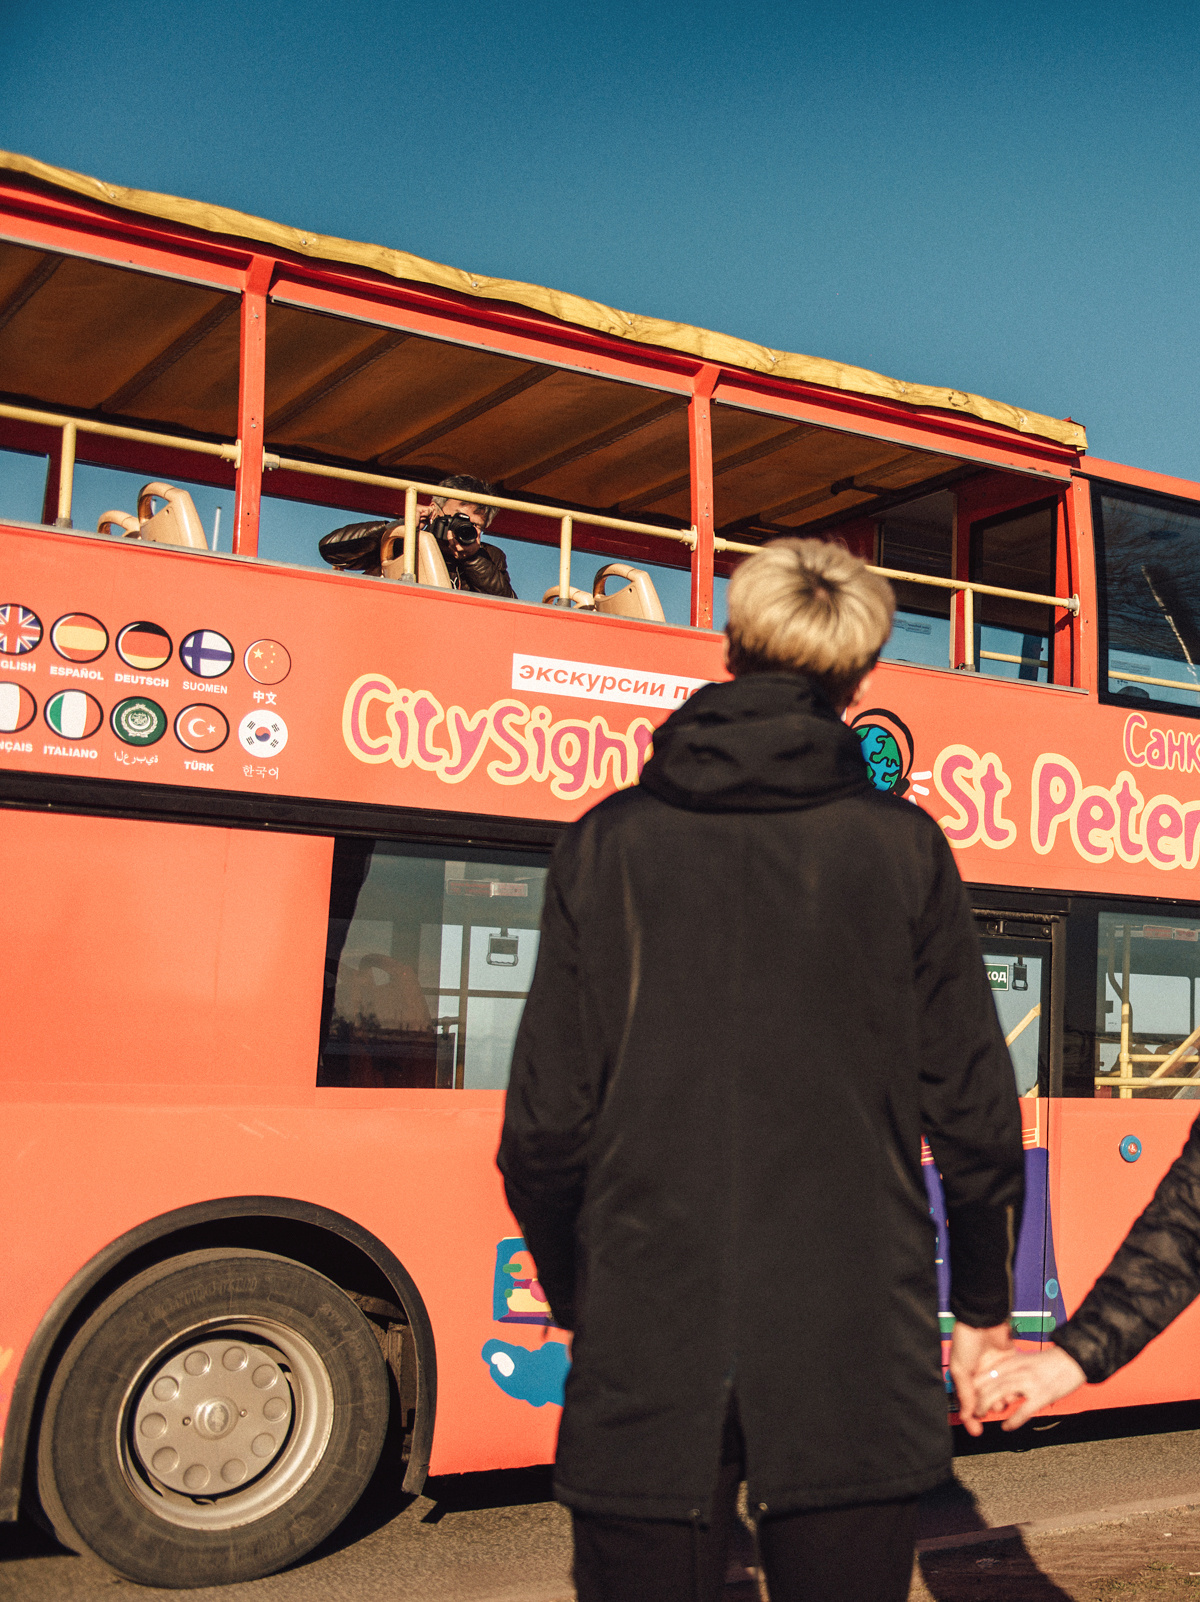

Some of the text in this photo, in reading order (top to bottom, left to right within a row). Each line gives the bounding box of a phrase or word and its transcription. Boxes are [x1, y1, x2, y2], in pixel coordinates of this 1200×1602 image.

[0, 660, 36, 672] GLISH
[50, 665, 104, 681] ESPAÑOL
[115, 673, 169, 688] DEUTSCH
[182, 681, 228, 694] SUOMEN
[519, 664, 665, 697] экскурсии
[253, 690, 277, 705] 中文
[0, 741, 33, 753] NÇAIS
[43, 745, 98, 759] ITALIANO
[184, 760, 214, 772] TÜRK
[243, 764, 279, 779] 한국어
[933, 744, 1017, 849] St
